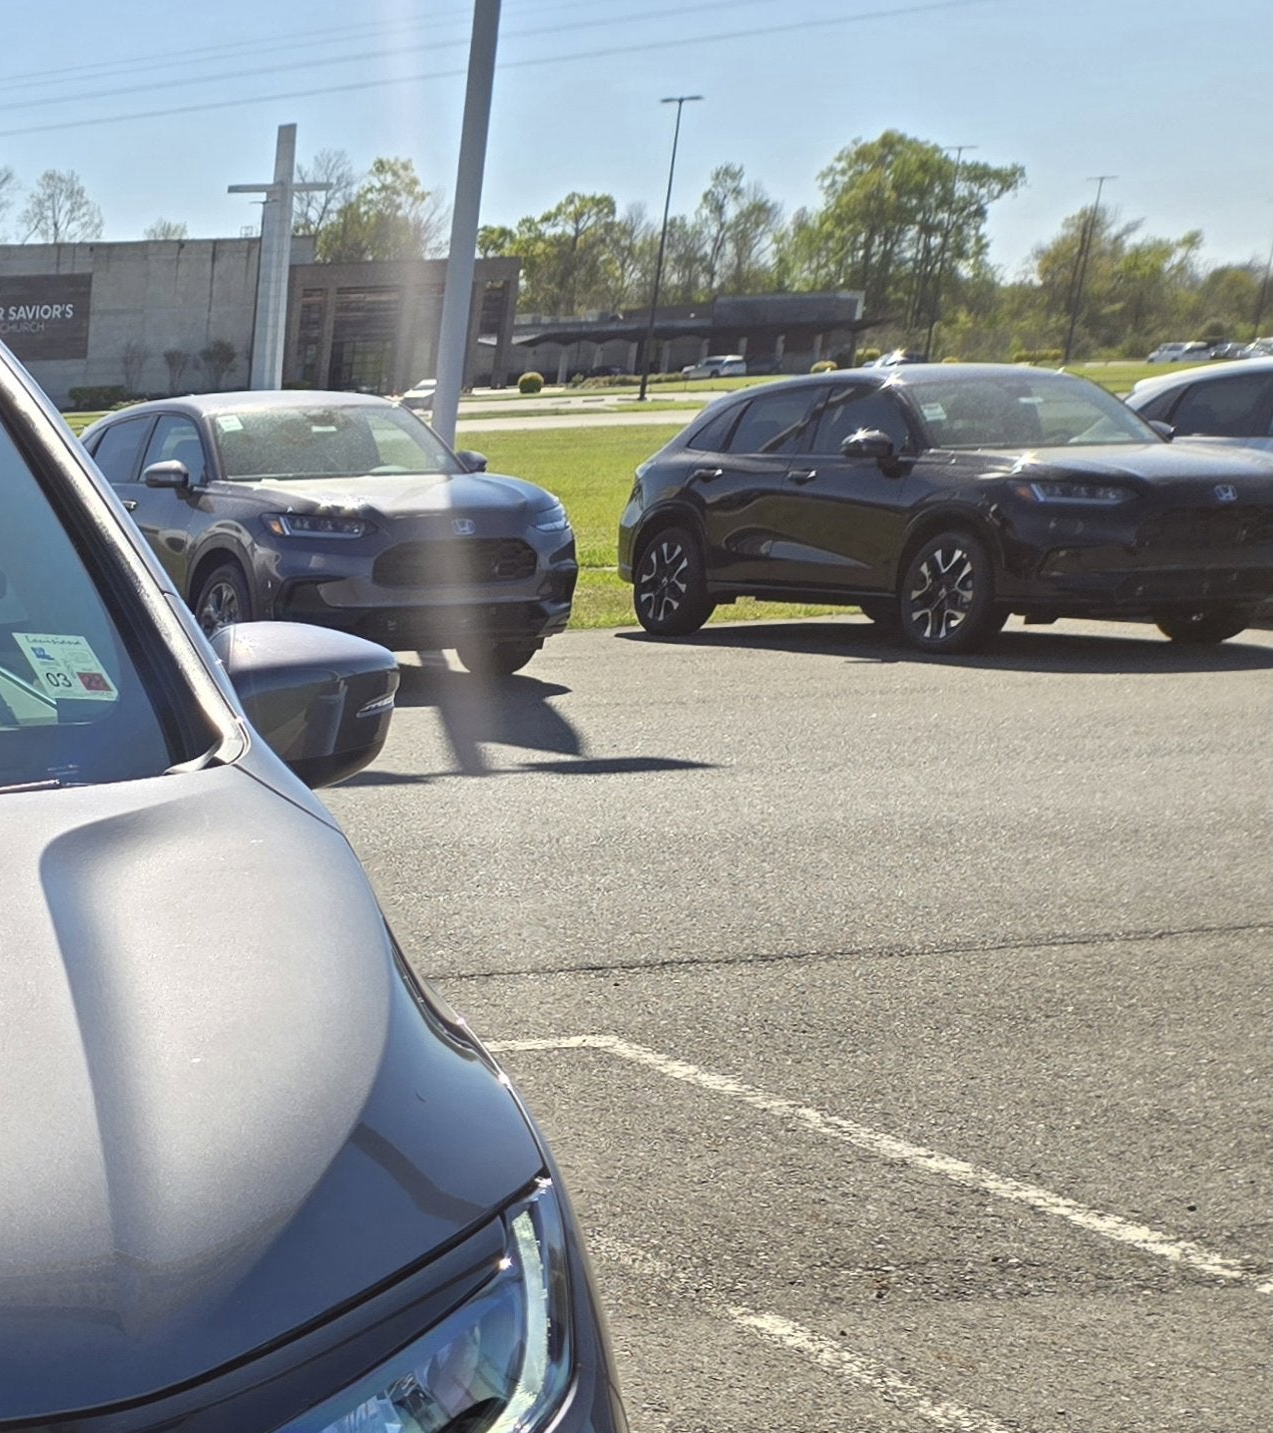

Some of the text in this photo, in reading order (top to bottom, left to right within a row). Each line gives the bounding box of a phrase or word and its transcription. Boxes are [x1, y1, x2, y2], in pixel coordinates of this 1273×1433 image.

[8, 304, 73, 320] SAVIOR'S
[0, 321, 45, 333] CHURCH
[46, 672, 73, 688] 03
